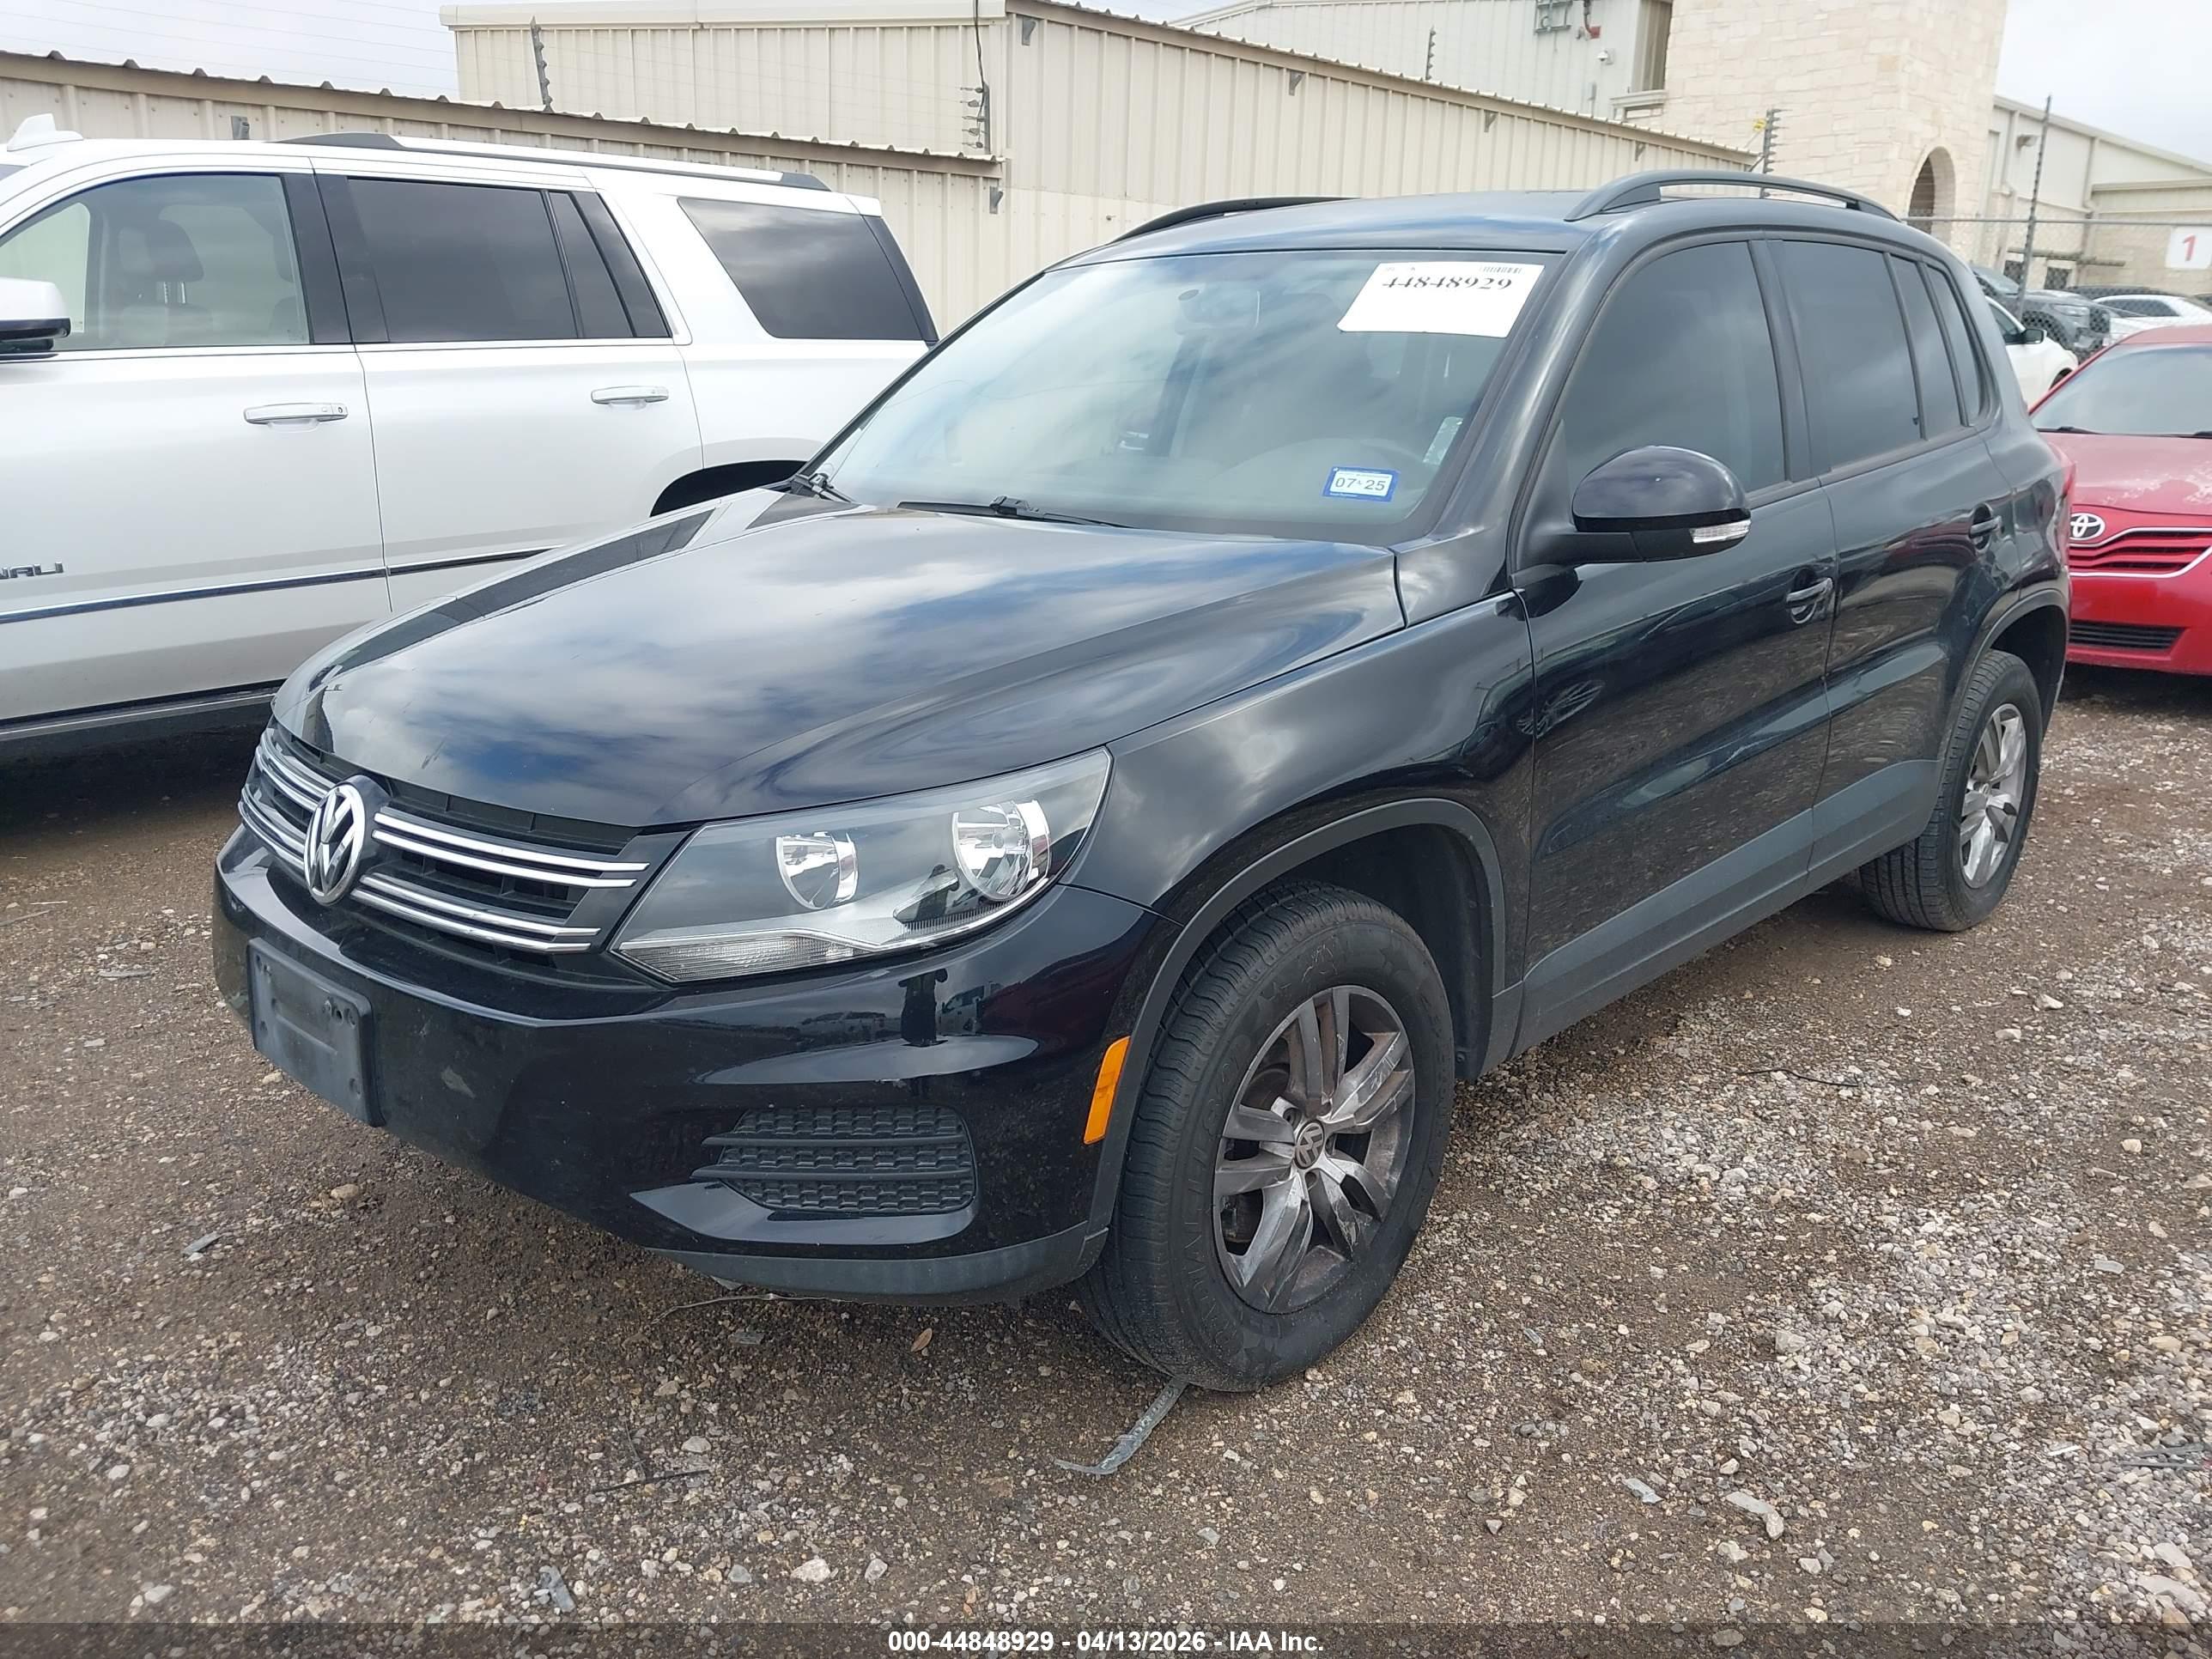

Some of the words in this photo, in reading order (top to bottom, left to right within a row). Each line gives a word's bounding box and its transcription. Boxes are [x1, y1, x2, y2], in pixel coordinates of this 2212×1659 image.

[2182, 234, 2197, 262] 1
[1382, 276, 1512, 290] 44848929
[1334, 477, 1357, 489] 07
[1364, 479, 1386, 491] 25
